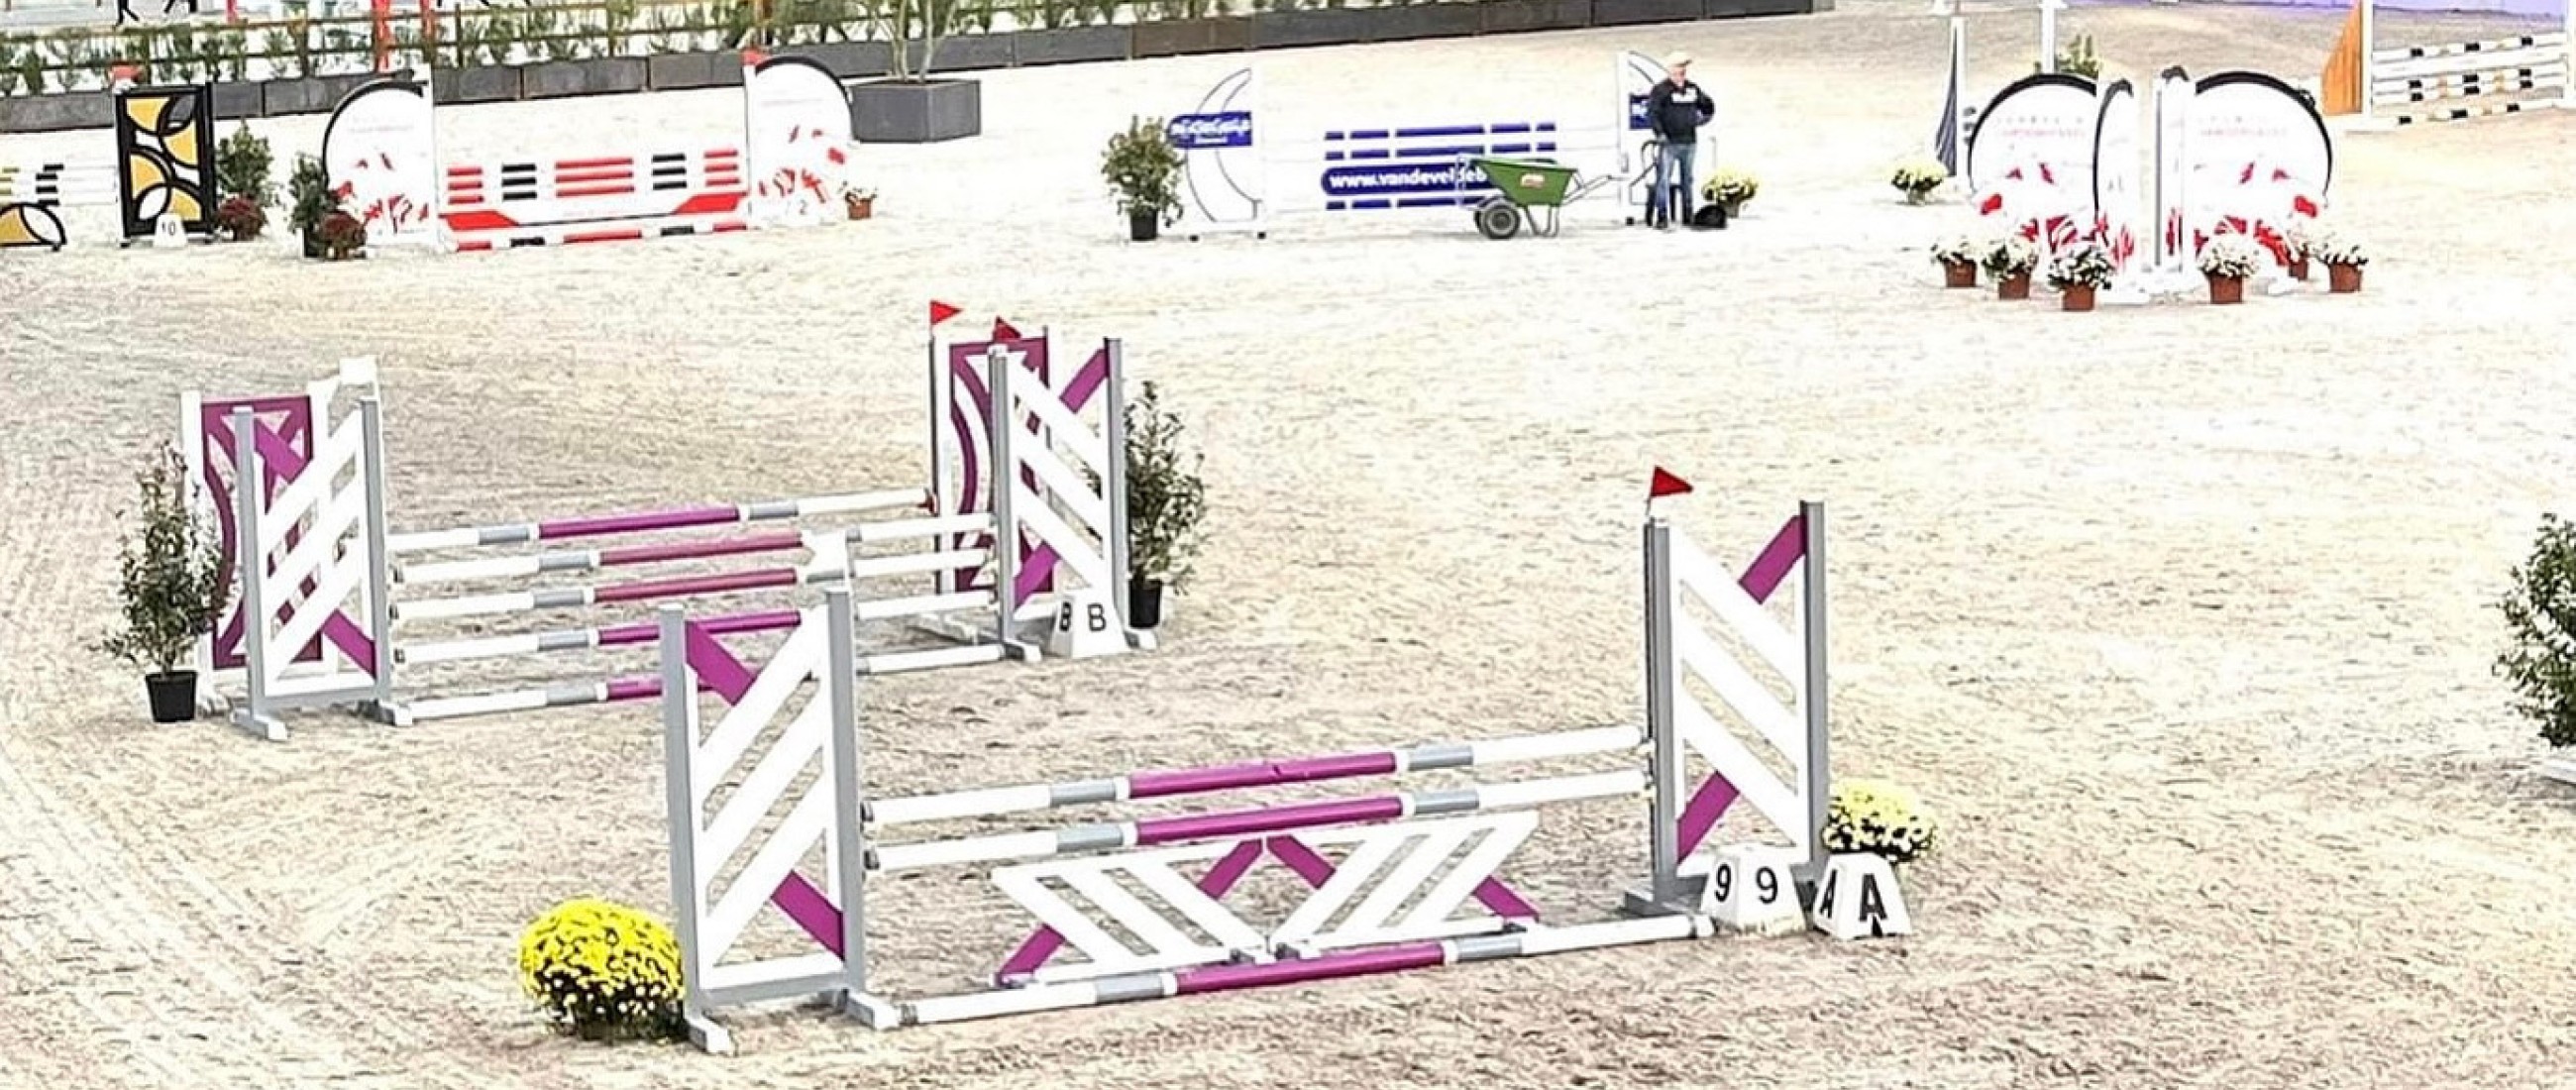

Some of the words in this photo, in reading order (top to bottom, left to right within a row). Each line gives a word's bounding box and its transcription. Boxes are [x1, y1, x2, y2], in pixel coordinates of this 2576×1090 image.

[1088, 603, 1107, 632] B
[1715, 863, 1732, 903] 9
[1757, 866, 1779, 905] 9
[1819, 870, 1837, 919] A
[1859, 874, 1887, 922] A
